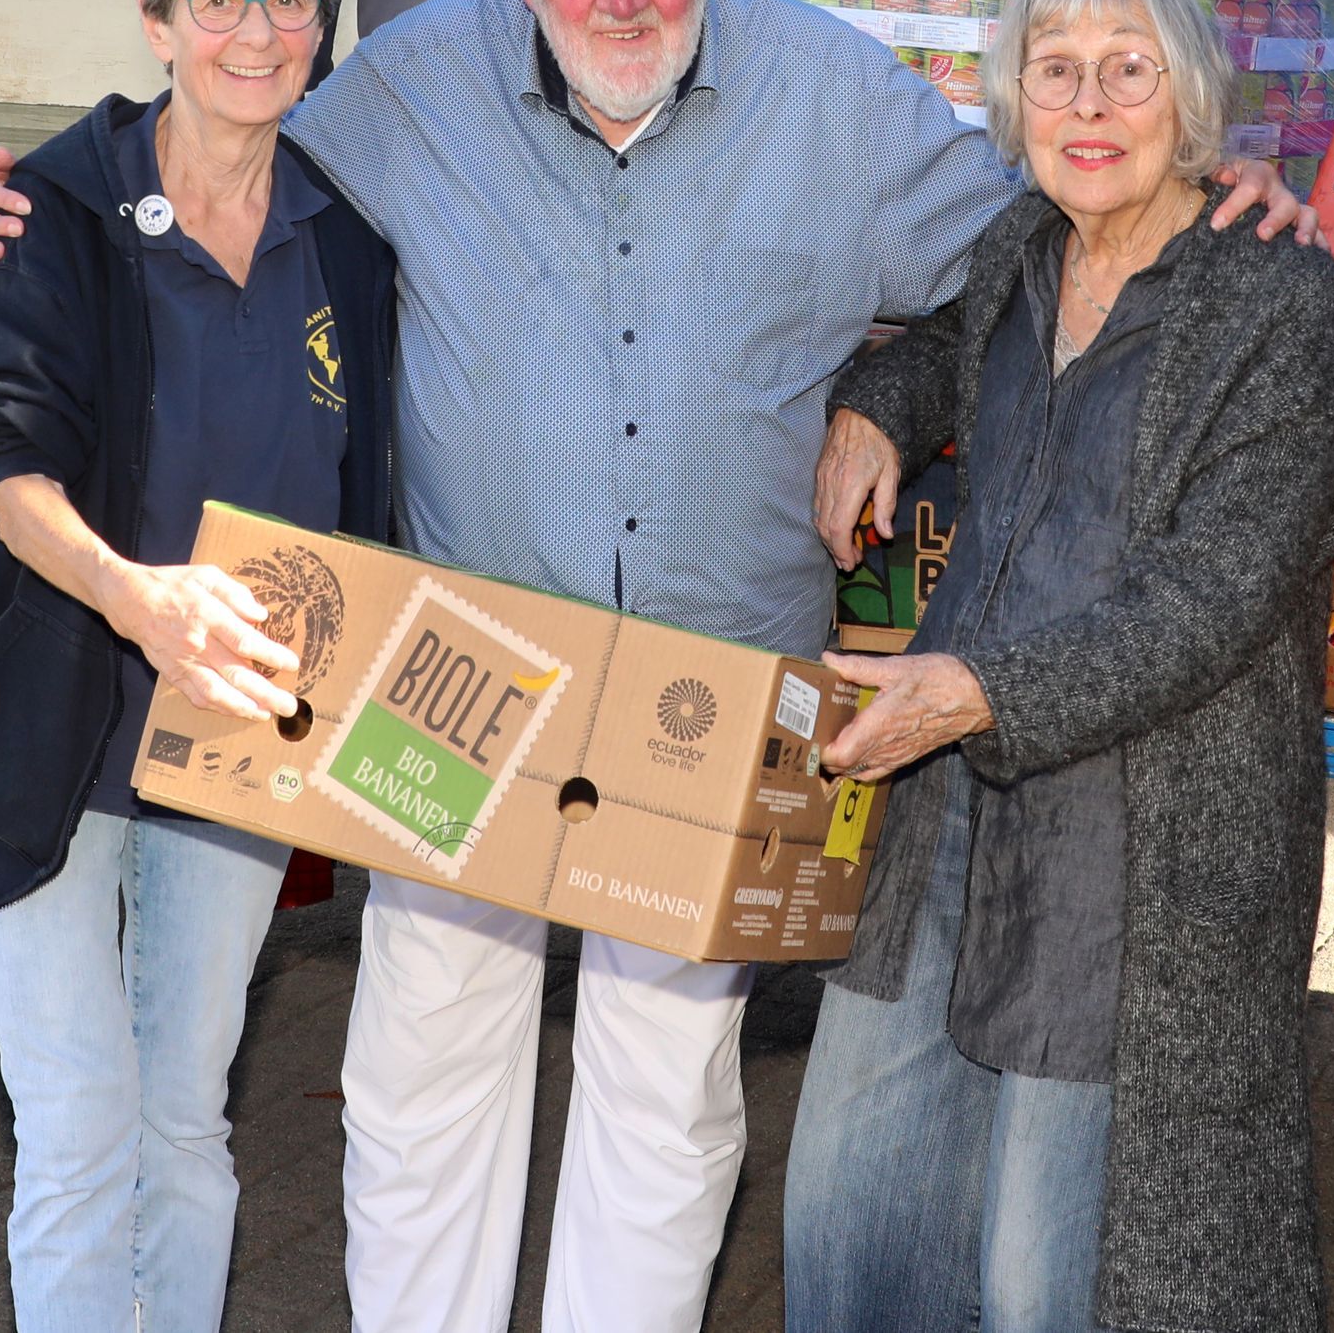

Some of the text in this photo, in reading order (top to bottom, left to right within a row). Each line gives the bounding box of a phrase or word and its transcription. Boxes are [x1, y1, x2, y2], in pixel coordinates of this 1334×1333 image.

[386, 628, 525, 768] BIOLE
[396, 744, 437, 786] BIO
[647, 738, 707, 763] ecuador
[651, 751, 696, 772] love life
[353, 756, 458, 835] BANANEN
[567, 866, 704, 923] BIO BANANEN
[733, 887, 777, 907] GREENYARD
